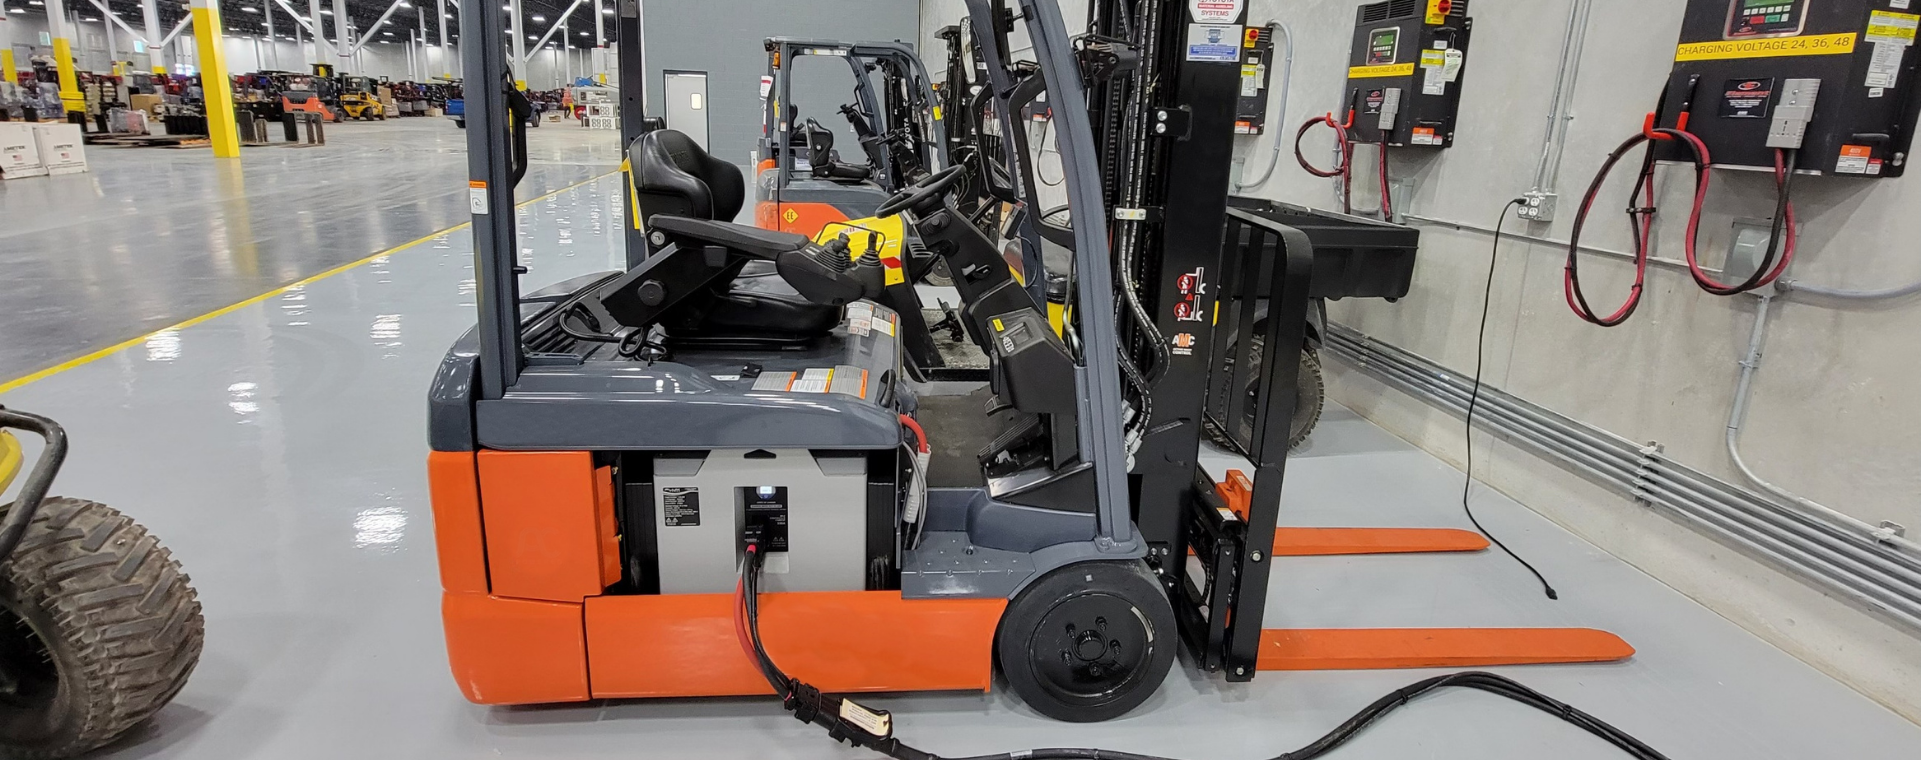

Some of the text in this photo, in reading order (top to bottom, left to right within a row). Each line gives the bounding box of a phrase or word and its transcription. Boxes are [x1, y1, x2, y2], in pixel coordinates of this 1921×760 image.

[1677, 36, 1850, 55] CHARGING VOLTAGE 24, 36, 48
[786, 211, 794, 220] EE
[1172, 333, 1195, 347] AMC
